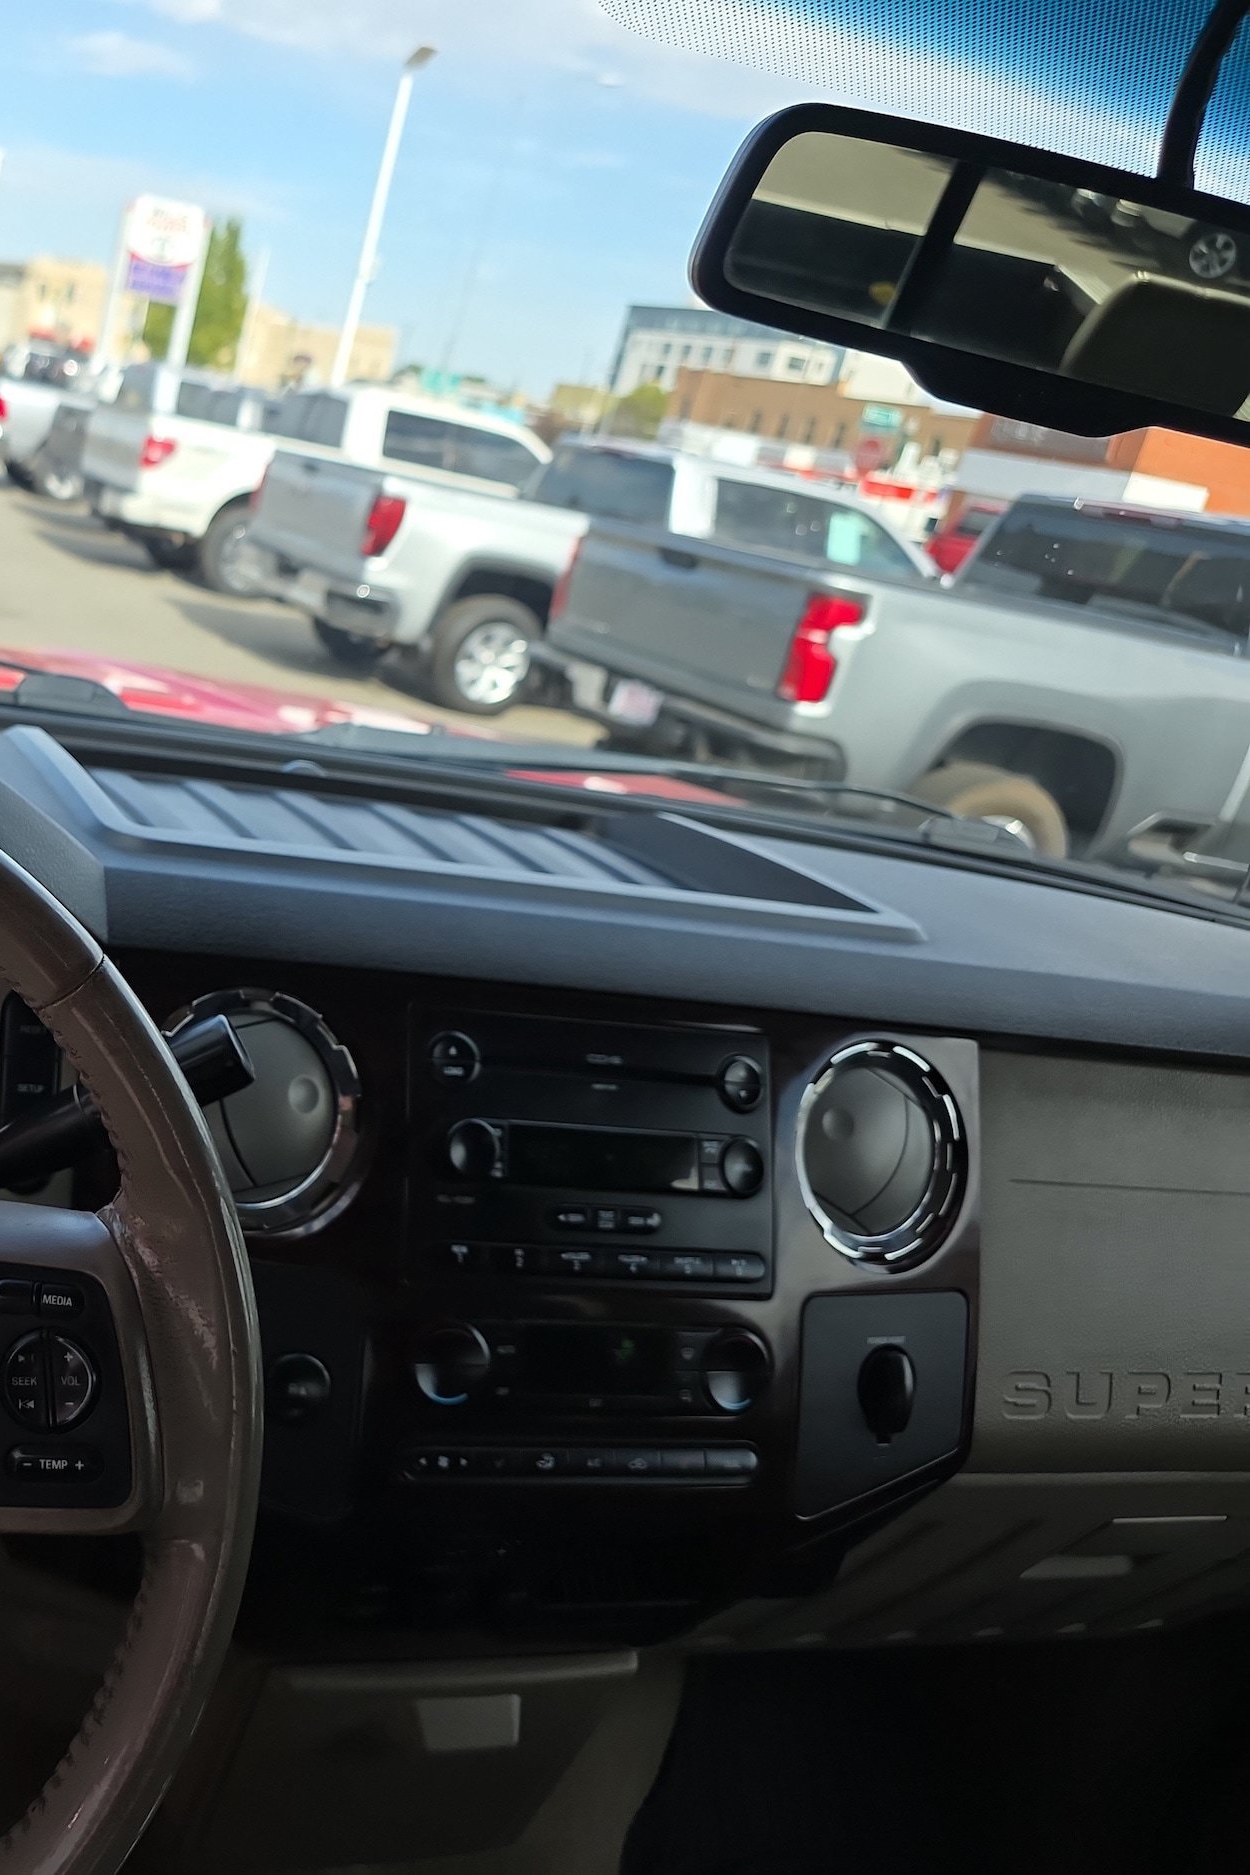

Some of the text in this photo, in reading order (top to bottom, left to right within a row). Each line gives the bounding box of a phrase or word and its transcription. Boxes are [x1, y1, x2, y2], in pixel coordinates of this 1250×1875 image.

[16, 1083, 45, 1094] SETUP
[42, 1294, 73, 1307] MEDIA
[11, 1376, 38, 1387] SEEK
[60, 1376, 82, 1387] VOL
[38, 1459, 68, 1471] TEMP
